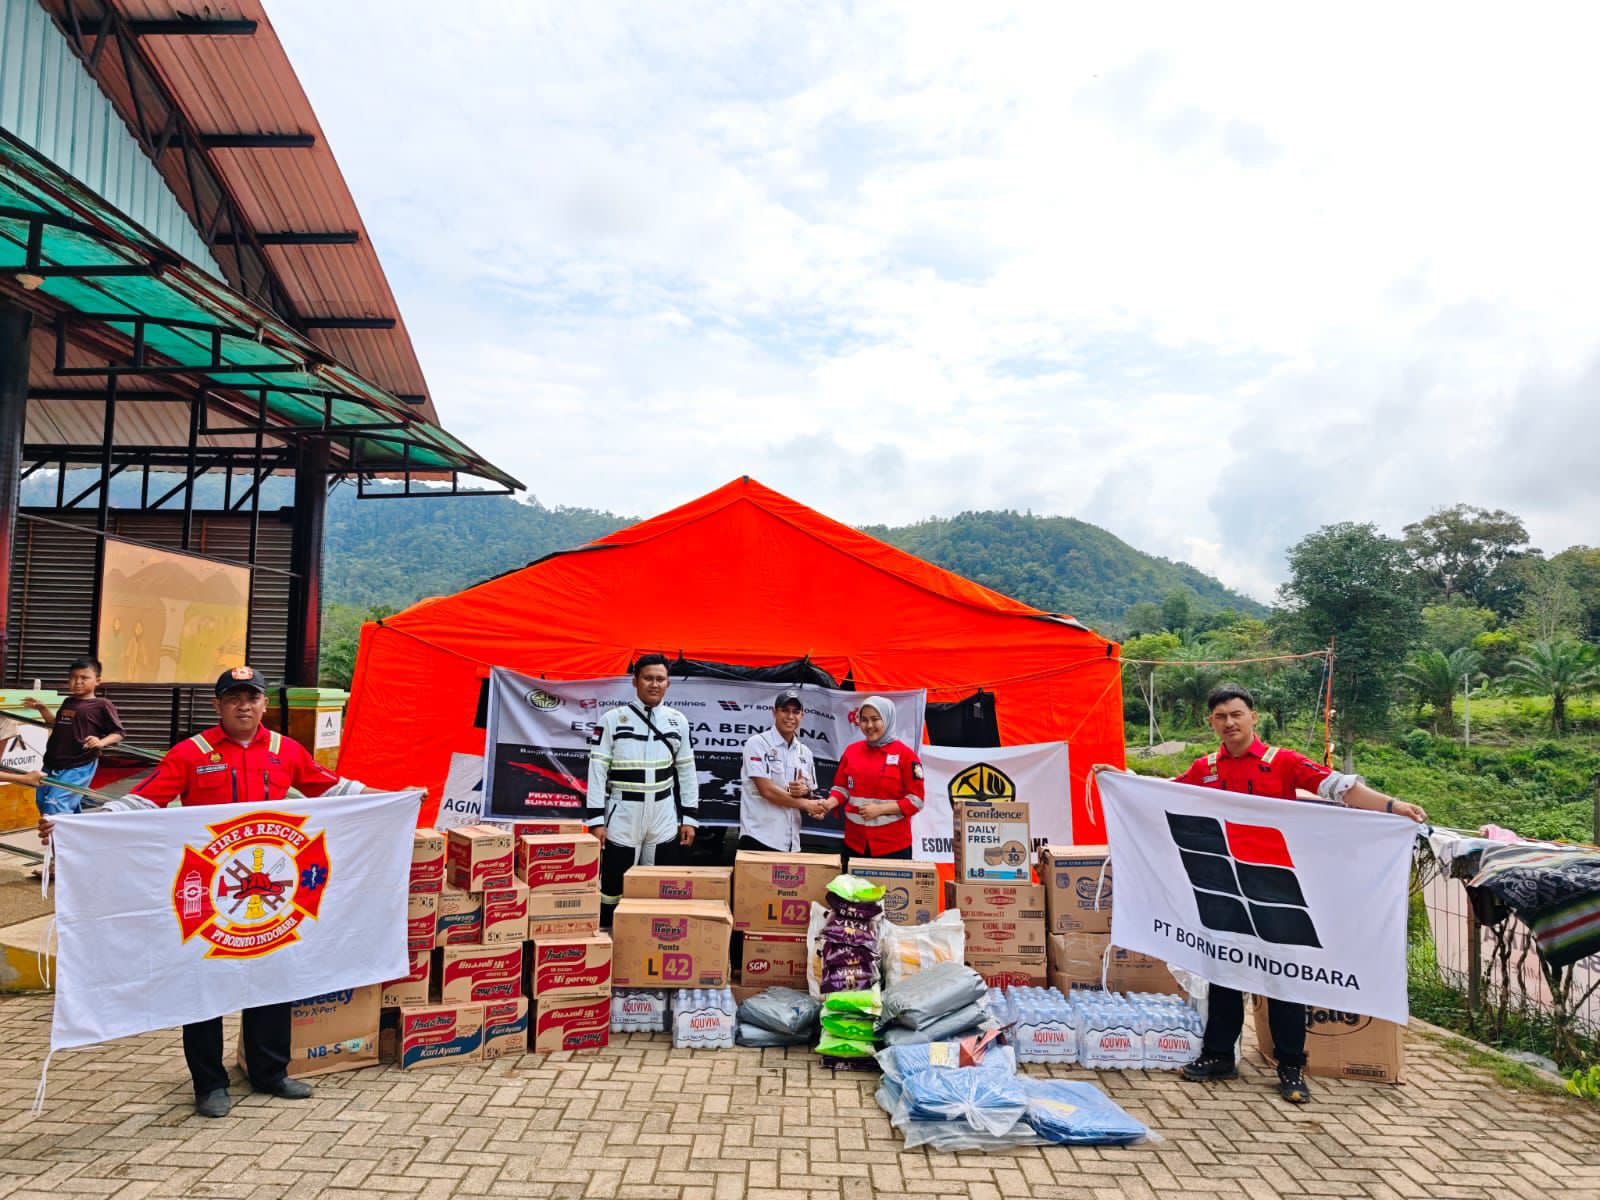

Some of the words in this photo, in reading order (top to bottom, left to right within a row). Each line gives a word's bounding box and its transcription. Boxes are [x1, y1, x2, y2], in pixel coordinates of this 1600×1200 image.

[1, 755, 37, 768] GINCOURT
[524, 799, 579, 807] SUMATERA
[966, 808, 1023, 819] Confidence
[967, 825, 997, 834] DAILY
[208, 829, 242, 856] FIRE
[243, 826, 253, 837] &
[256, 823, 306, 847] RESCUE
[967, 835, 1001, 844] FRESH
[554, 873, 587, 882] goreng
[777, 889, 798, 897] Pants
[767, 903, 777, 920] L
[784, 905, 807, 921] 42
[211, 929, 224, 940] PT
[256, 917, 299, 946] INDOBARA
[1154, 919, 1172, 938] PT
[1176, 927, 1244, 964] BORNEO
[1248, 951, 1361, 991] INDOBARA
[647, 958, 658, 976] L
[665, 959, 689, 976] 42
[748, 961, 768, 971] SGM
[565, 976, 598, 985] goreng
[622, 1001, 653, 1013] AQUVIVA
[689, 1016, 721, 1028] AQUVIVA
[1031, 1030, 1065, 1042] AQUVIVA
[1098, 1038, 1132, 1049] AQUVIVA
[1157, 1038, 1191, 1050] AQUVIVA
[307, 1043, 342, 1059] NB-S
[420, 1048, 439, 1057] Kari
[439, 1046, 462, 1056] Ayam
